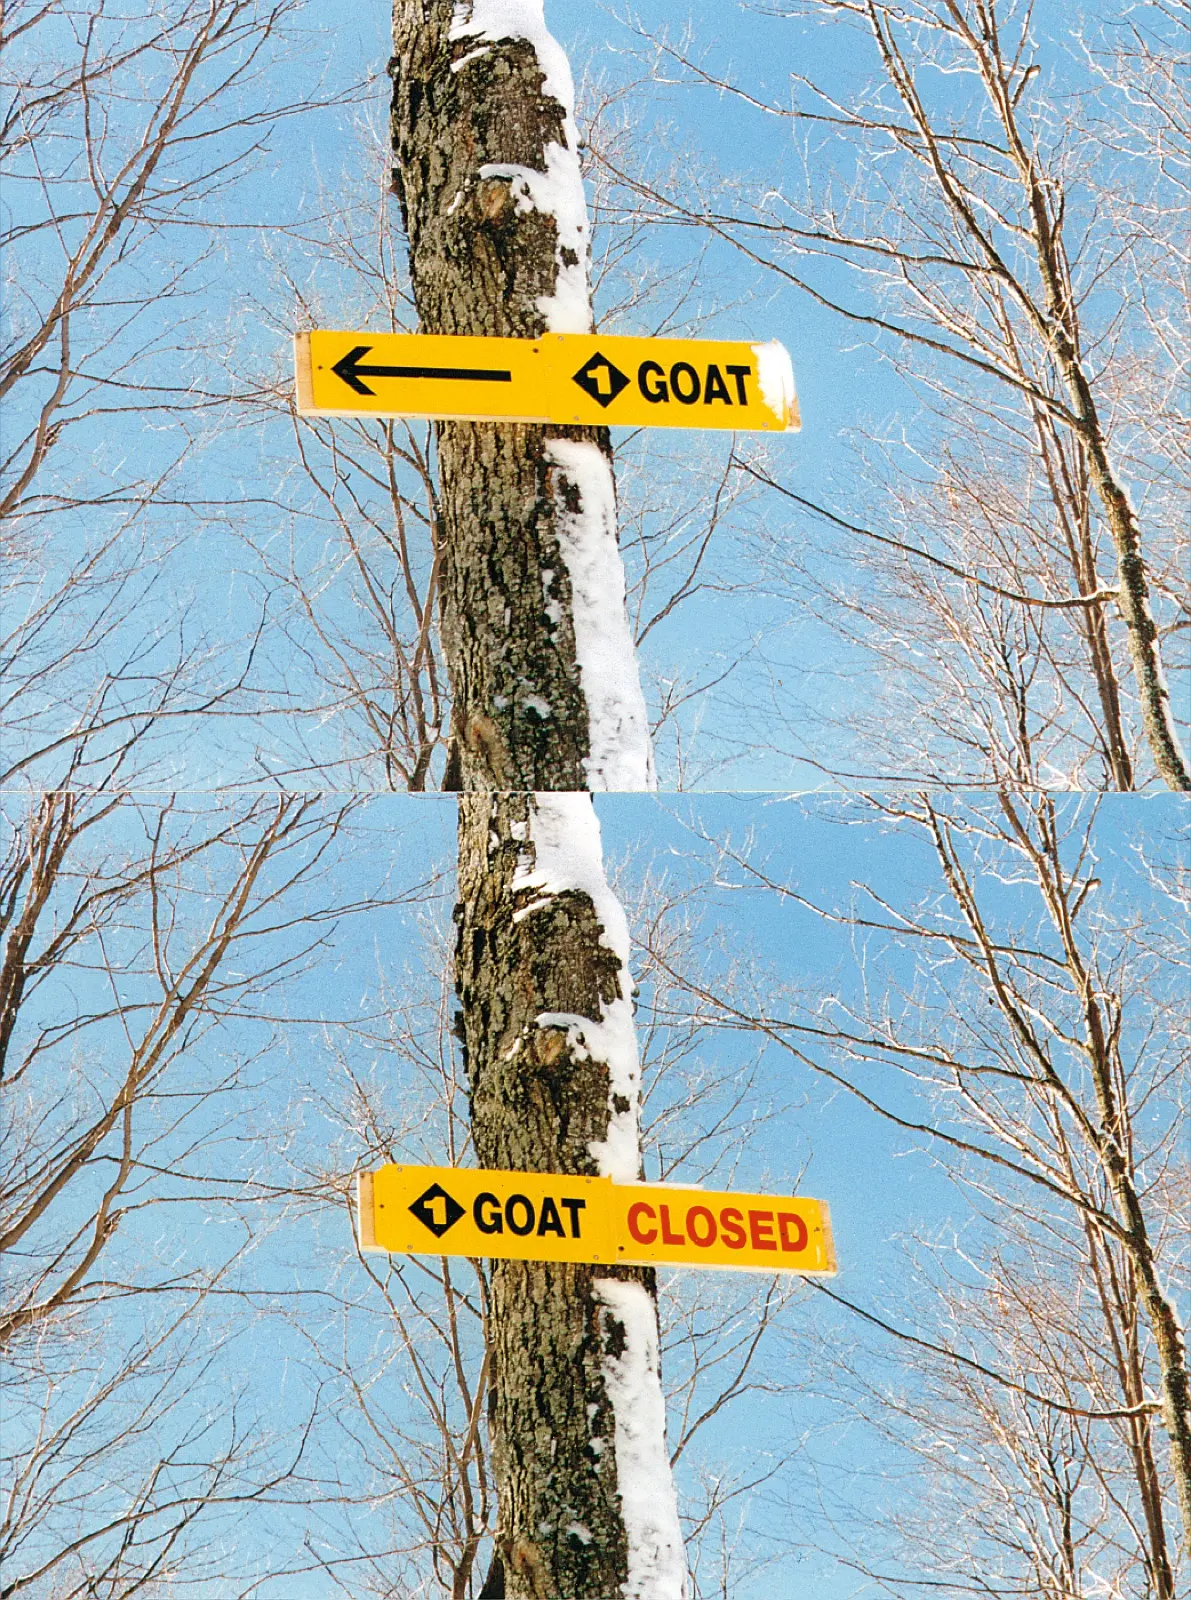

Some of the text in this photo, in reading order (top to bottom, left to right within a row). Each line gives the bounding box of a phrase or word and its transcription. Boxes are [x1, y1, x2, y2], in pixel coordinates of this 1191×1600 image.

[586, 360, 751, 406] 1 GOAT
[422, 1192, 809, 1252] 1 GOAT CLOSED
